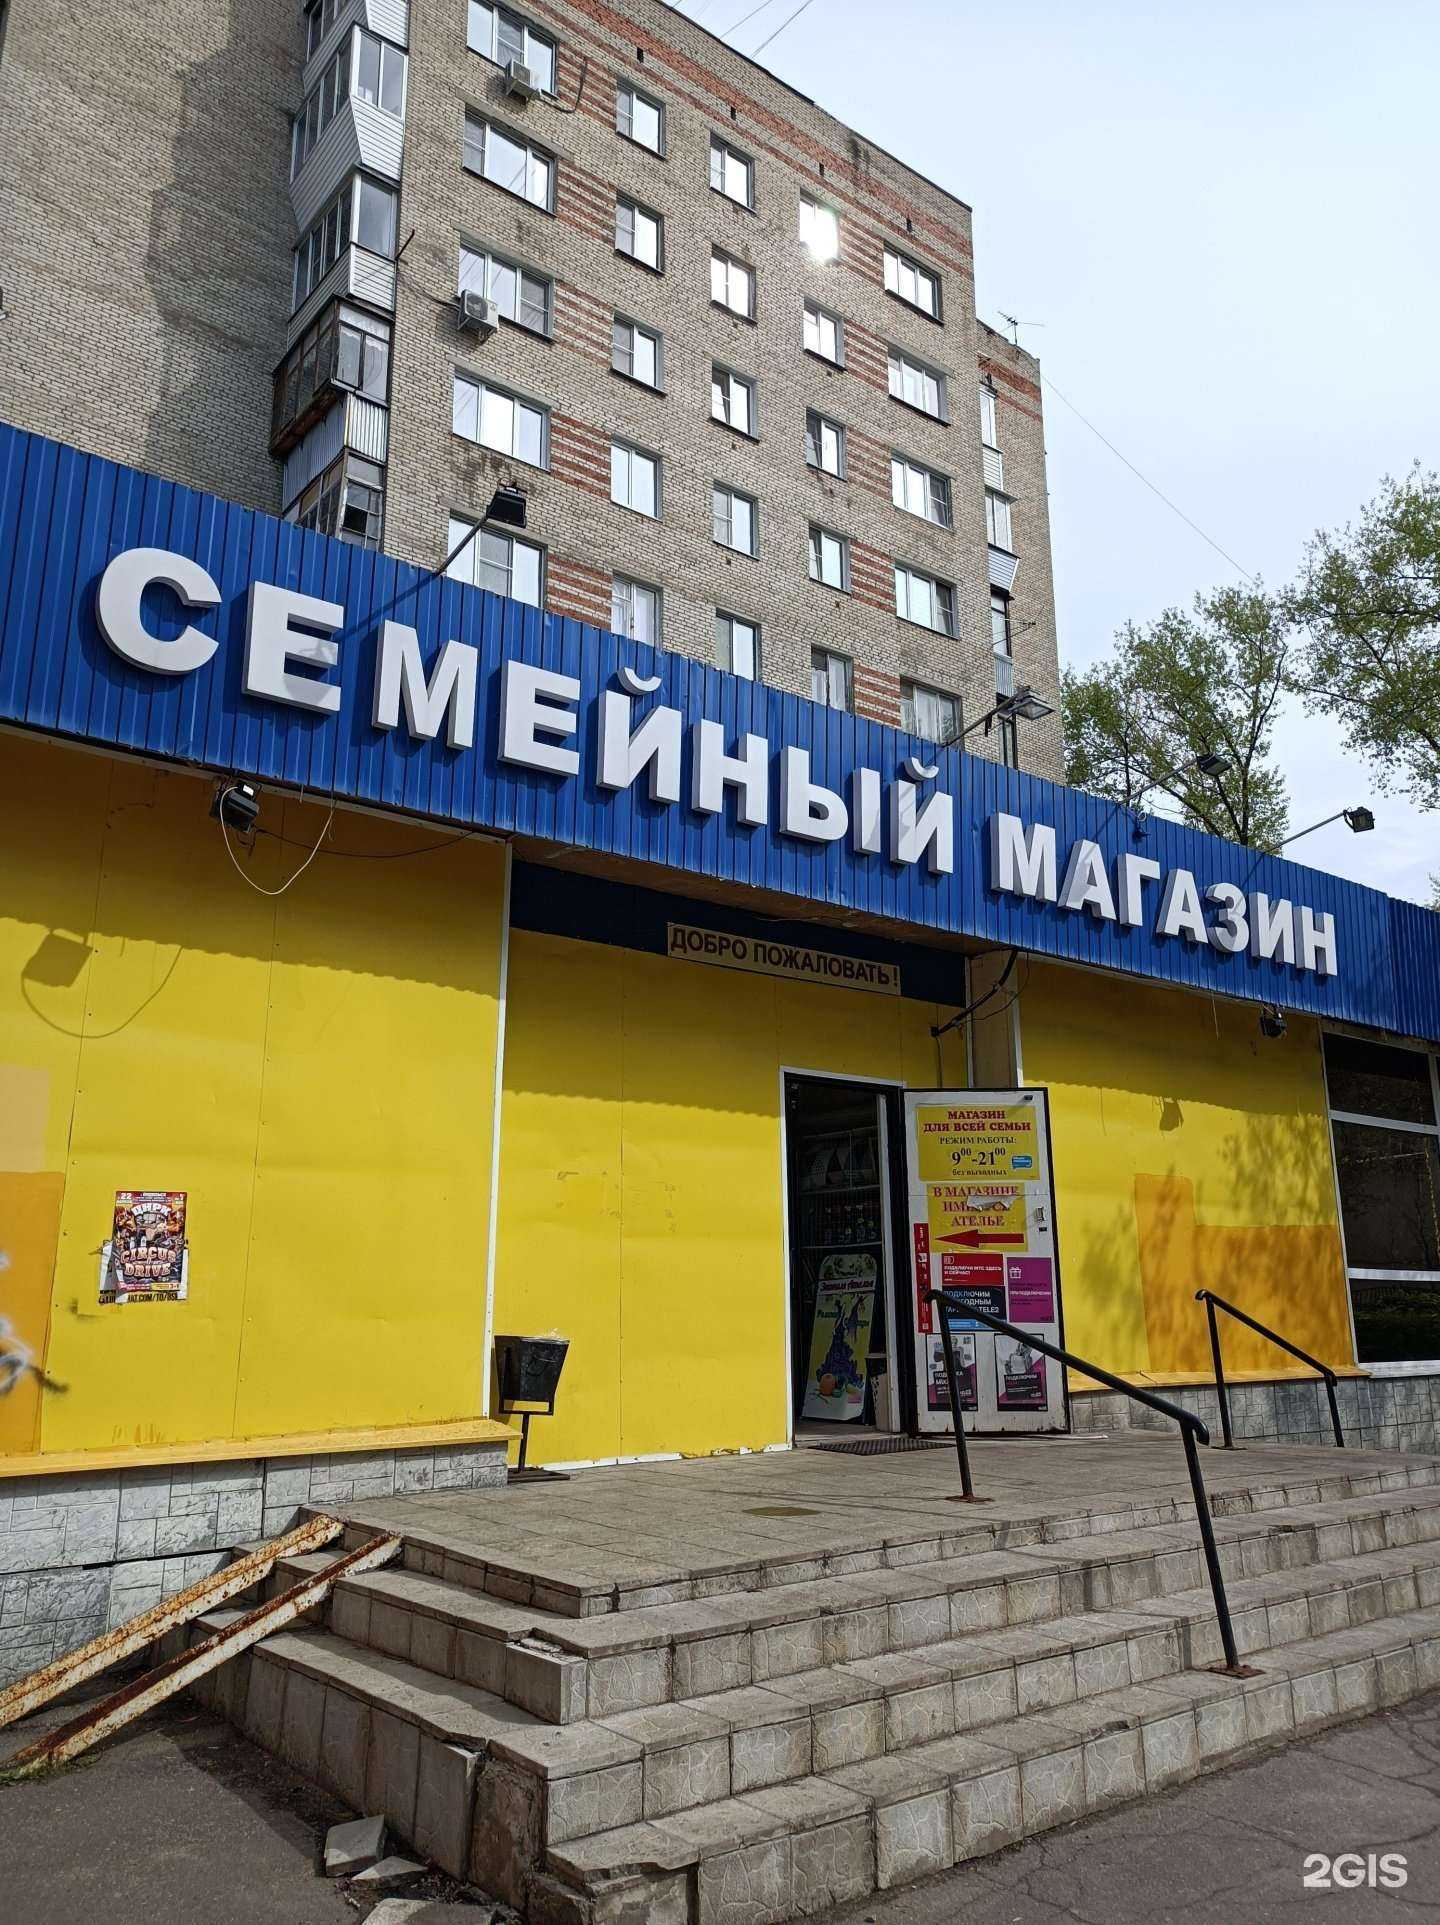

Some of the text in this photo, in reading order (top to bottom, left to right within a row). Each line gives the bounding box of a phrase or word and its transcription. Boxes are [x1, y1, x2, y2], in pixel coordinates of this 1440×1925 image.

[97, 547, 1338, 976] СЕМЕЙНЫЙ МАГАЗИН
[670, 927, 900, 987] ДОБРО ПОЖАЛОВАТЬ!
[947, 1110, 1006, 1120] МАГАЗИН
[923, 1120, 1032, 1132] ДЛЯ ВСЕЙ СЕМЬИ
[939, 1136, 974, 1145] РЕЖИМ
[952, 1168, 1008, 1176] без выходных
[933, 1185, 1018, 1197] В МАГАЗИНЕ
[951, 1215, 1005, 1227] АТЕЛЬЕ
[120, 1246, 177, 1264] CIRCUS
[124, 1263, 172, 1278] DRIVE
[944, 1290, 990, 1298] ПОДКЛЮЧИМ
